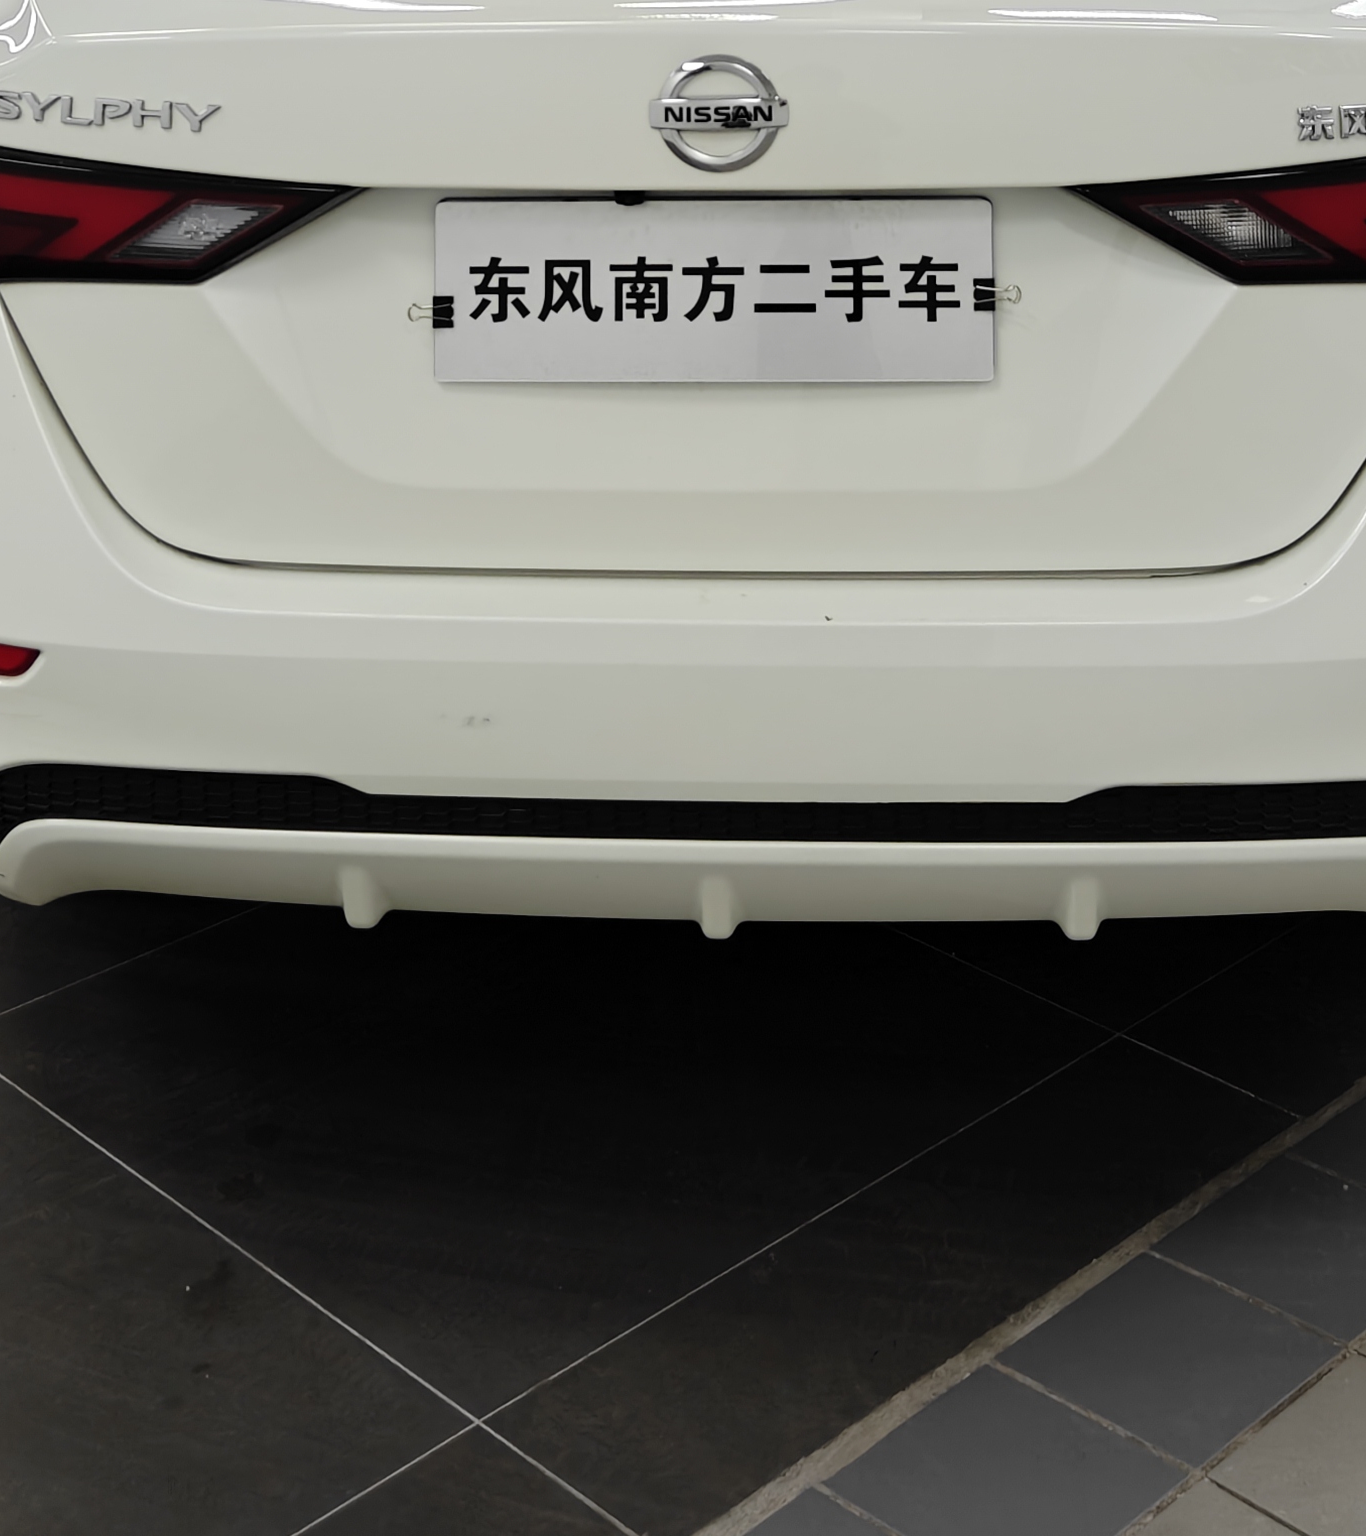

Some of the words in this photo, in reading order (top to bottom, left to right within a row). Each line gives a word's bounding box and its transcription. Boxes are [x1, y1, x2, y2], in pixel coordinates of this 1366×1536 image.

[664, 105, 773, 123] NISSAN
[468, 255, 961, 323] 东风南方二手车
